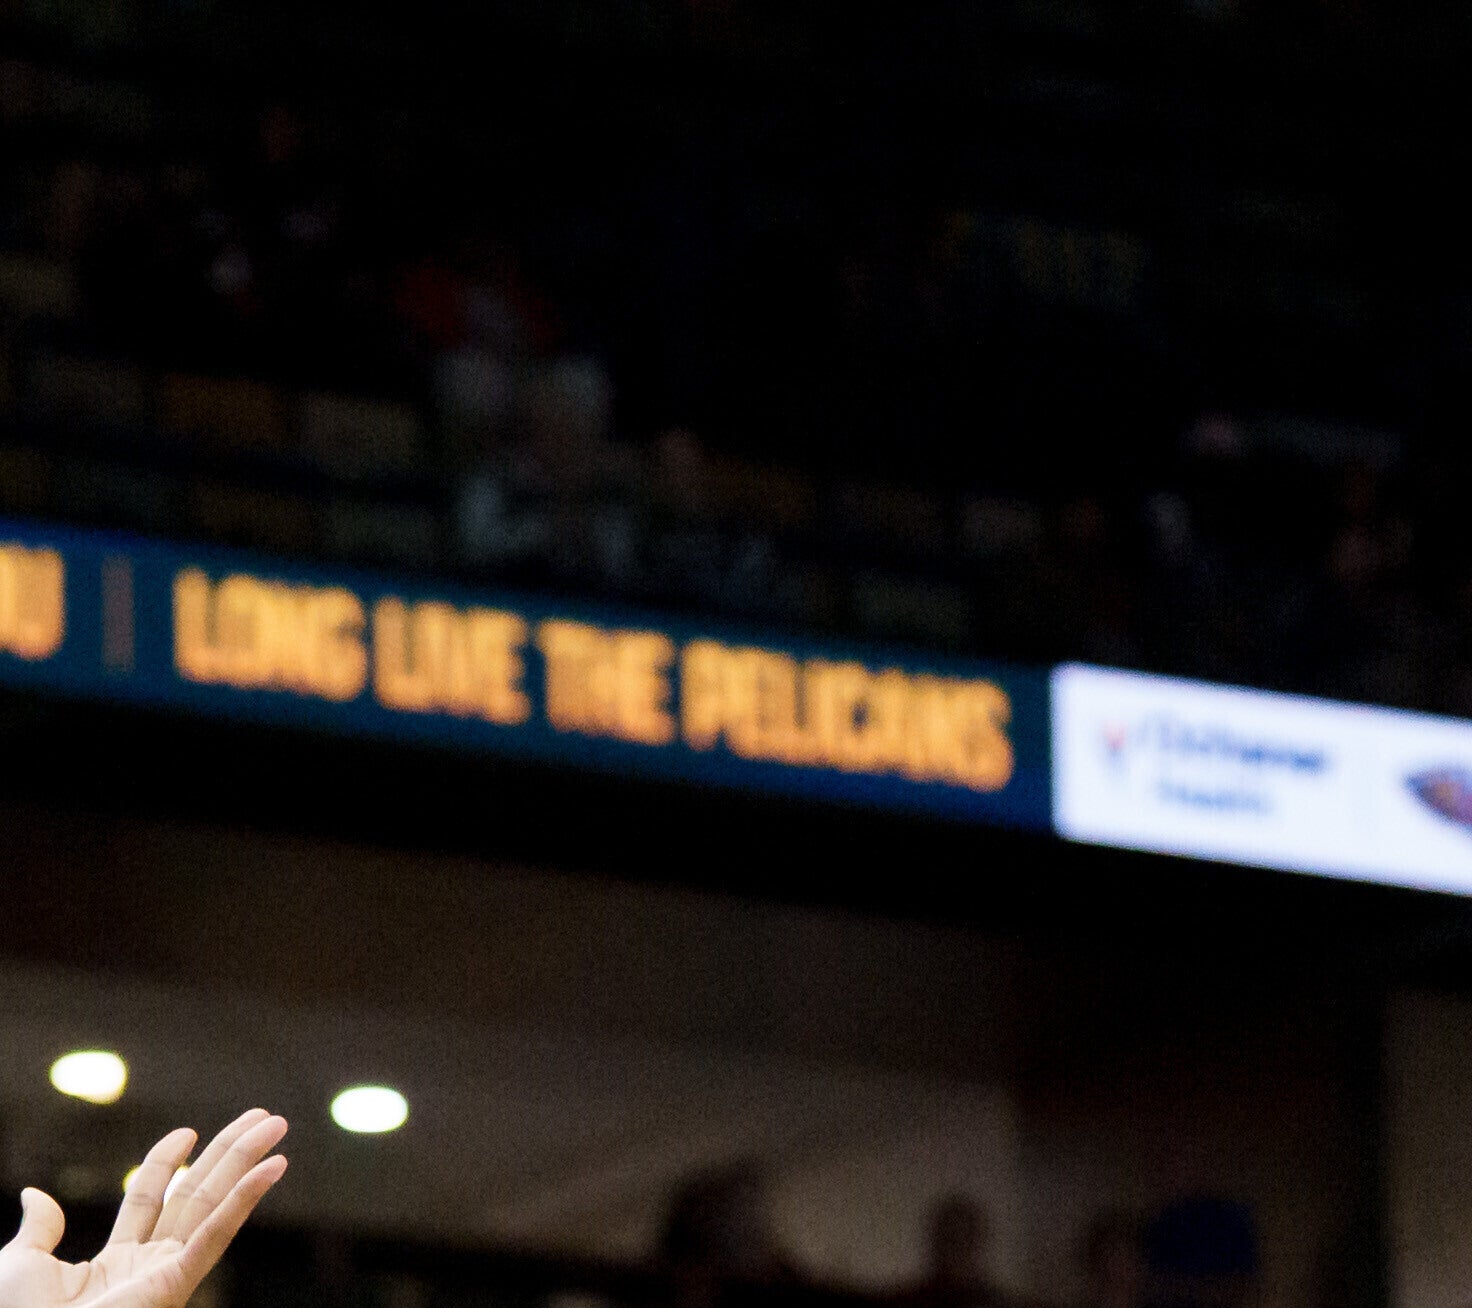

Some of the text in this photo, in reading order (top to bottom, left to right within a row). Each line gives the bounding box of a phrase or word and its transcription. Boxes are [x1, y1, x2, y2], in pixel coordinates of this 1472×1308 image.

[178, 576, 1009, 784] LONG LIVE THE PELICANS
